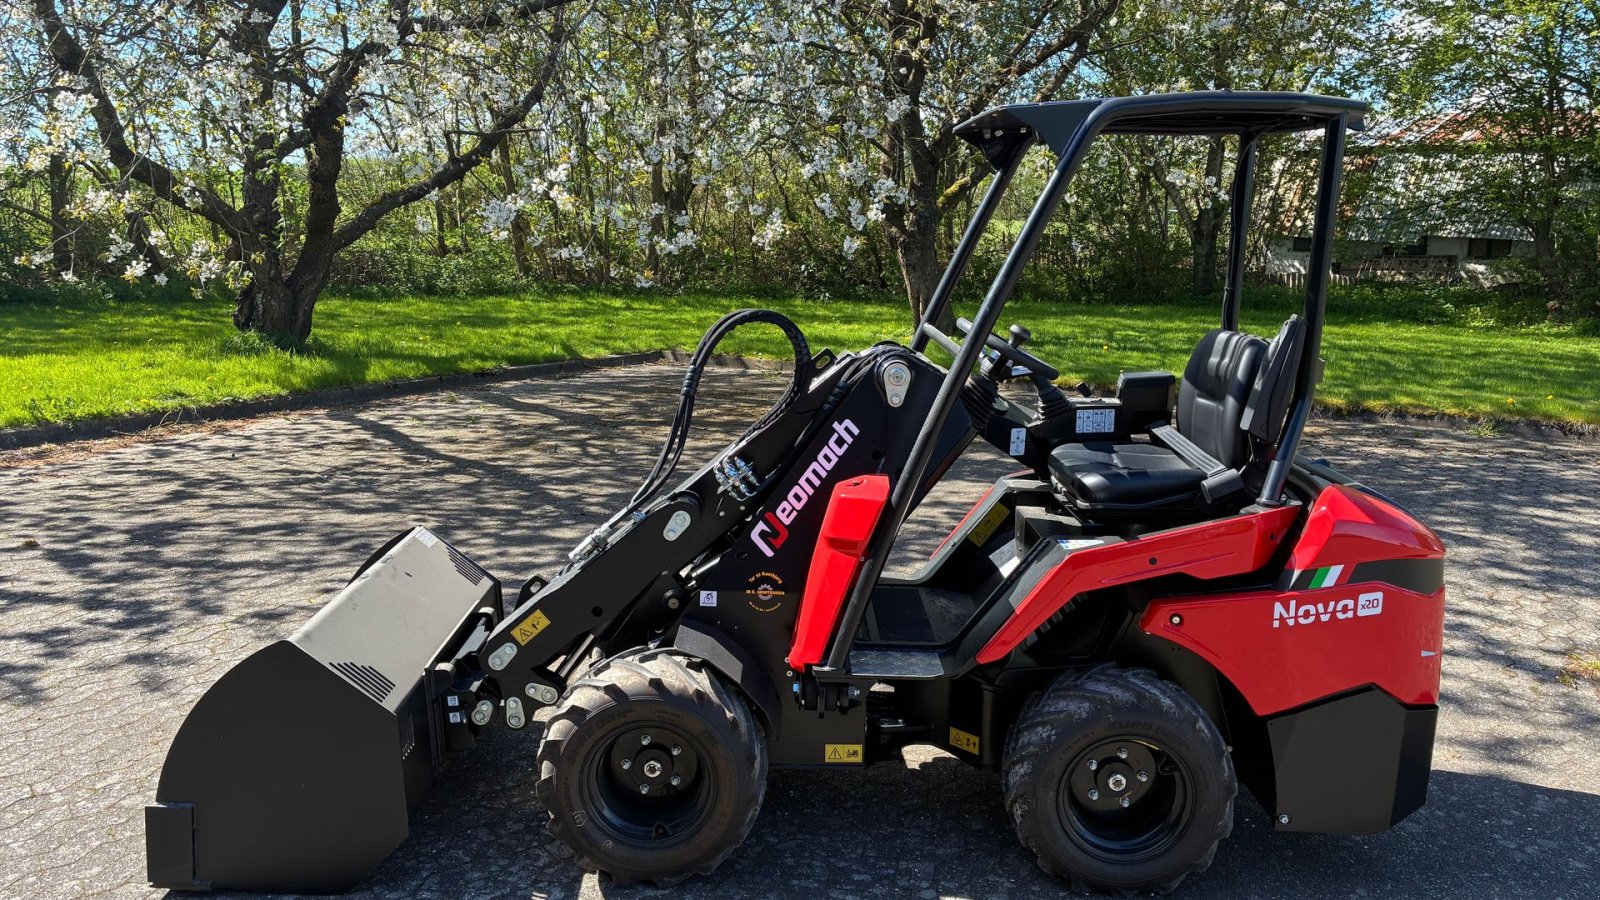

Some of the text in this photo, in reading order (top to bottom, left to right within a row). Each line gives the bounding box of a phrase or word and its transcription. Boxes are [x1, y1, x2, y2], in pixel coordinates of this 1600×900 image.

[751, 418, 860, 558] Neomach
[1272, 598, 1380, 628] Nova x20
